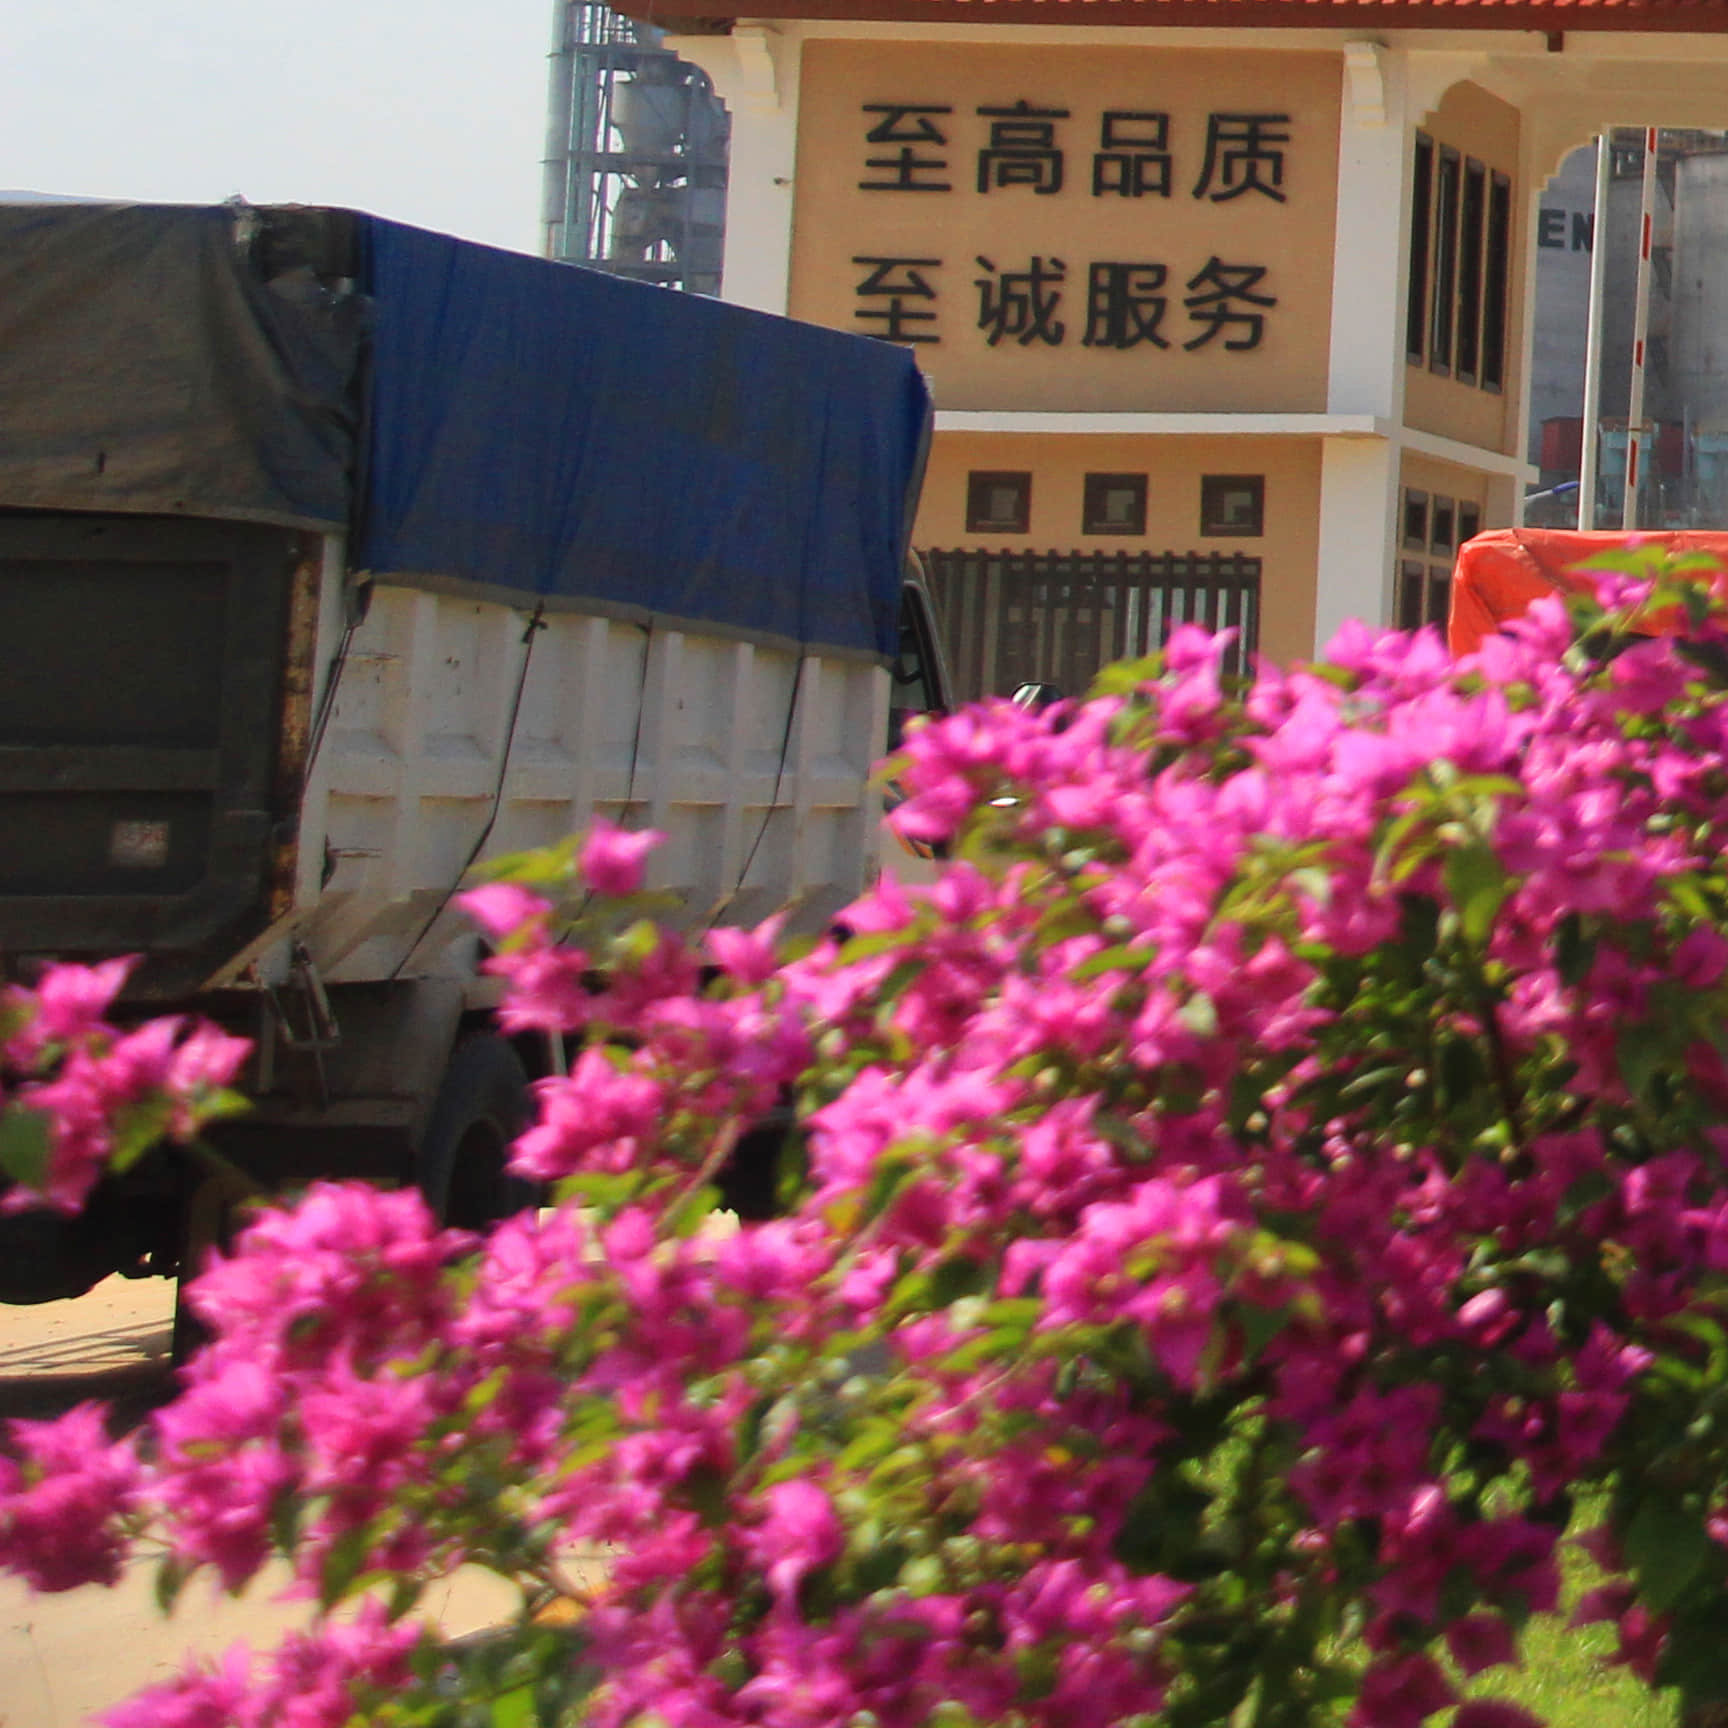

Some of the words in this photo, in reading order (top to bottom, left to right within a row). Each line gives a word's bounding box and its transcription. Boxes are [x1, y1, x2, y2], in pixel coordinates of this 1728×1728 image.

[858, 99, 1291, 204] 至高品质
[851, 255, 1278, 352] 至诚服务
